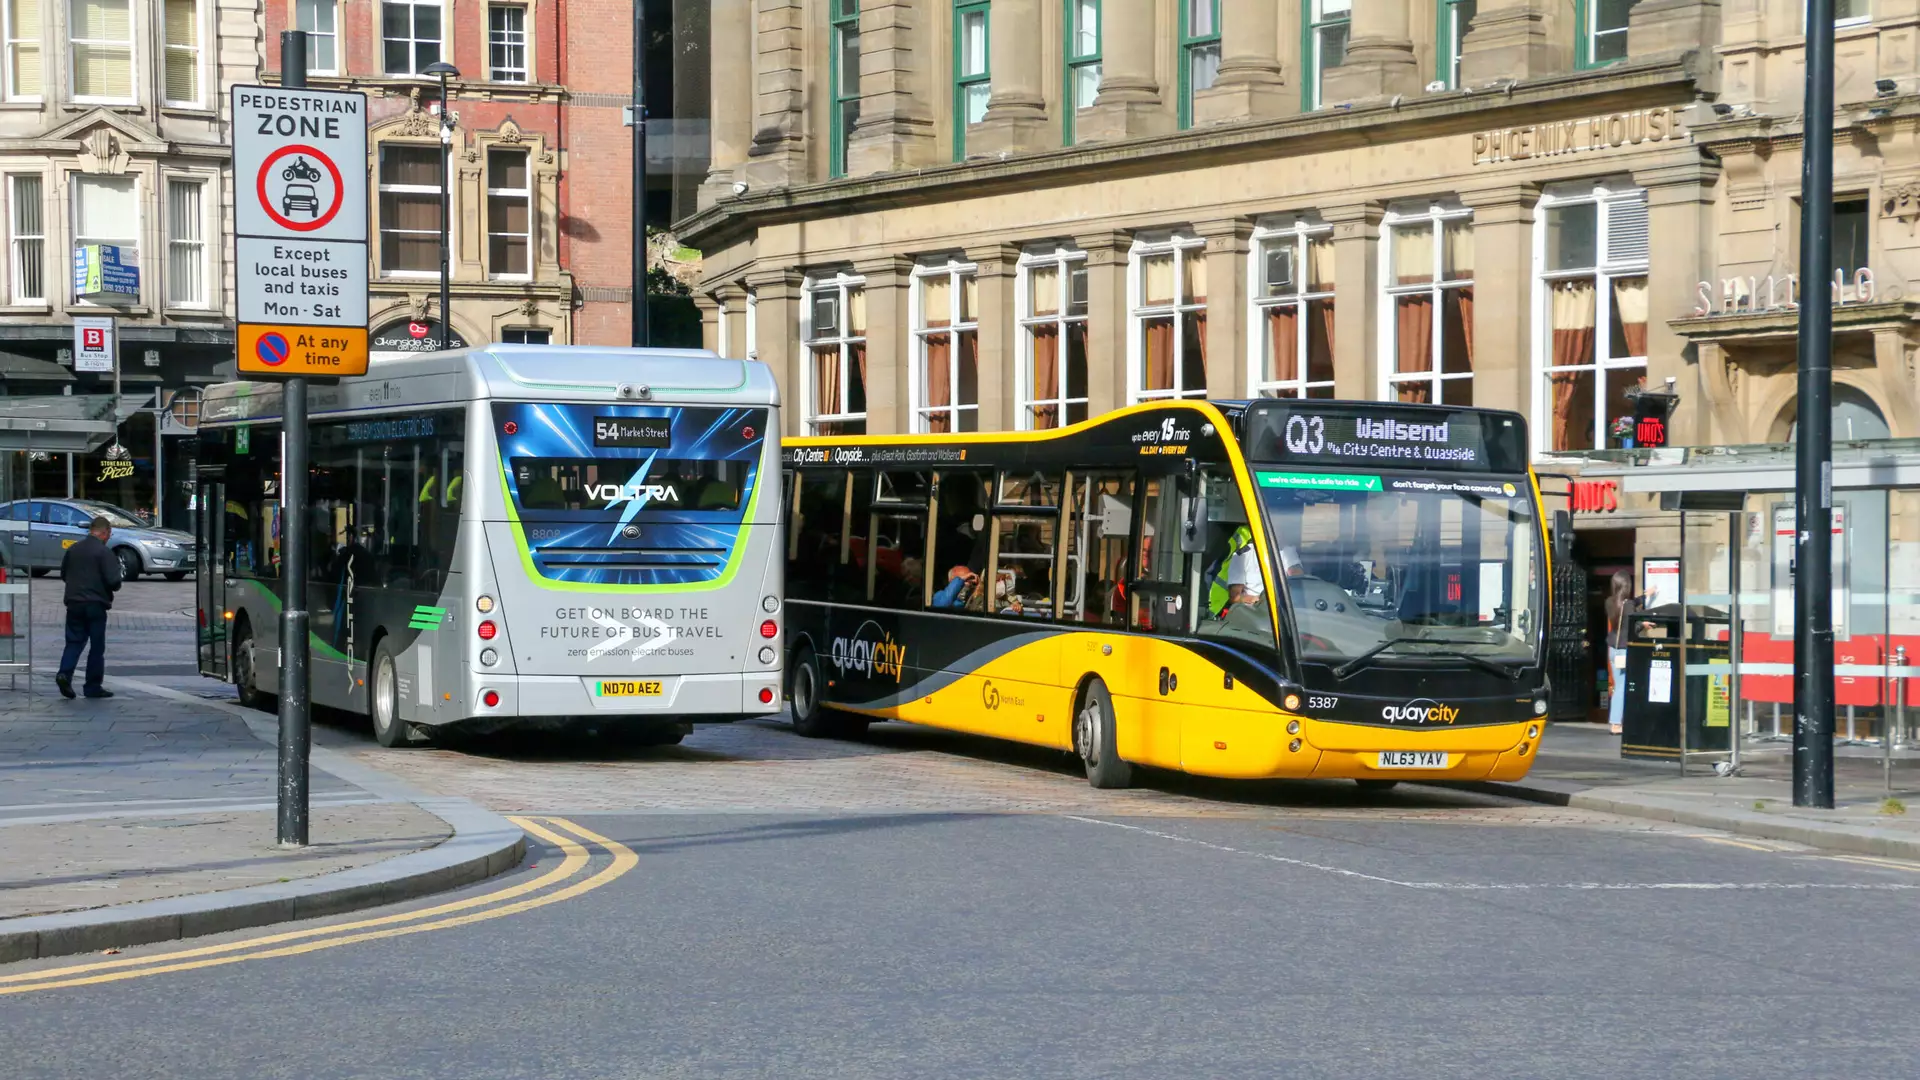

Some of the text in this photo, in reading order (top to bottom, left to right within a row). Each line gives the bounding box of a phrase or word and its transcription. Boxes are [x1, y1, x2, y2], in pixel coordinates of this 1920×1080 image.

[240, 94, 357, 114] PEDESTRIAN
[257, 113, 340, 139] ZONE
[1588, 105, 1686, 151] HOUSE
[102, 246, 112, 254] FOR
[273, 246, 330, 263] Except
[102, 256, 115, 264] SALE
[255, 262, 348, 280] local buses
[264, 281, 340, 296] and taxis
[1694, 266, 1875, 317] SHILLNG
[264, 302, 299, 316] Mon
[313, 304, 341, 318] Sat
[87, 330, 100, 344] B
[296, 334, 349, 351] At any
[305, 352, 341, 366] time
[383, 382, 389, 400] 11
[392, 420, 420, 438] ELECTRIC
[422, 418, 434, 436] BUS
[596, 422, 668, 440] 54 Market Street
[1142, 430, 1160, 444] every
[1162, 418, 1176, 441] 15
[1174, 428, 1190, 440] mins
[1285, 415, 1448, 454] Q3 Wallsend
[237, 428, 248, 449] 54
[794, 448, 806, 466] City
[804, 448, 824, 462] Centre
[1140, 446, 1188, 454] ALL DAY EVERY DAY
[1343, 442, 1368, 456] City
[1370, 444, 1412, 458] Centre
[1413, 446, 1422, 459] &
[1424, 446, 1475, 461] Quayside
[96, 466, 135, 482] Pizza
[1268, 476, 1288, 484] we're
[1289, 476, 1310, 485] clean
[1318, 478, 1334, 486] safe
[1344, 478, 1360, 486] ride
[584, 484, 678, 501] VOLTRA
[1412, 481, 1436, 490] forget
[1452, 482, 1470, 492] face
[1470, 484, 1502, 494] covering
[556, 608, 708, 620] GET ON BOARD THE
[346, 554, 354, 695] VOLTRA
[540, 626, 723, 638] FUTURE OF BUS TRAVEL
[590, 648, 630, 656] emission
[632, 648, 666, 656] electric
[668, 648, 694, 656] buses
[832, 631, 907, 684] quaycity
[604, 682, 660, 694] ND70 AEZ
[1308, 698, 1338, 709] 5387
[1382, 702, 1460, 724] quaycity
[1383, 752, 1444, 766] NL63 YAV
